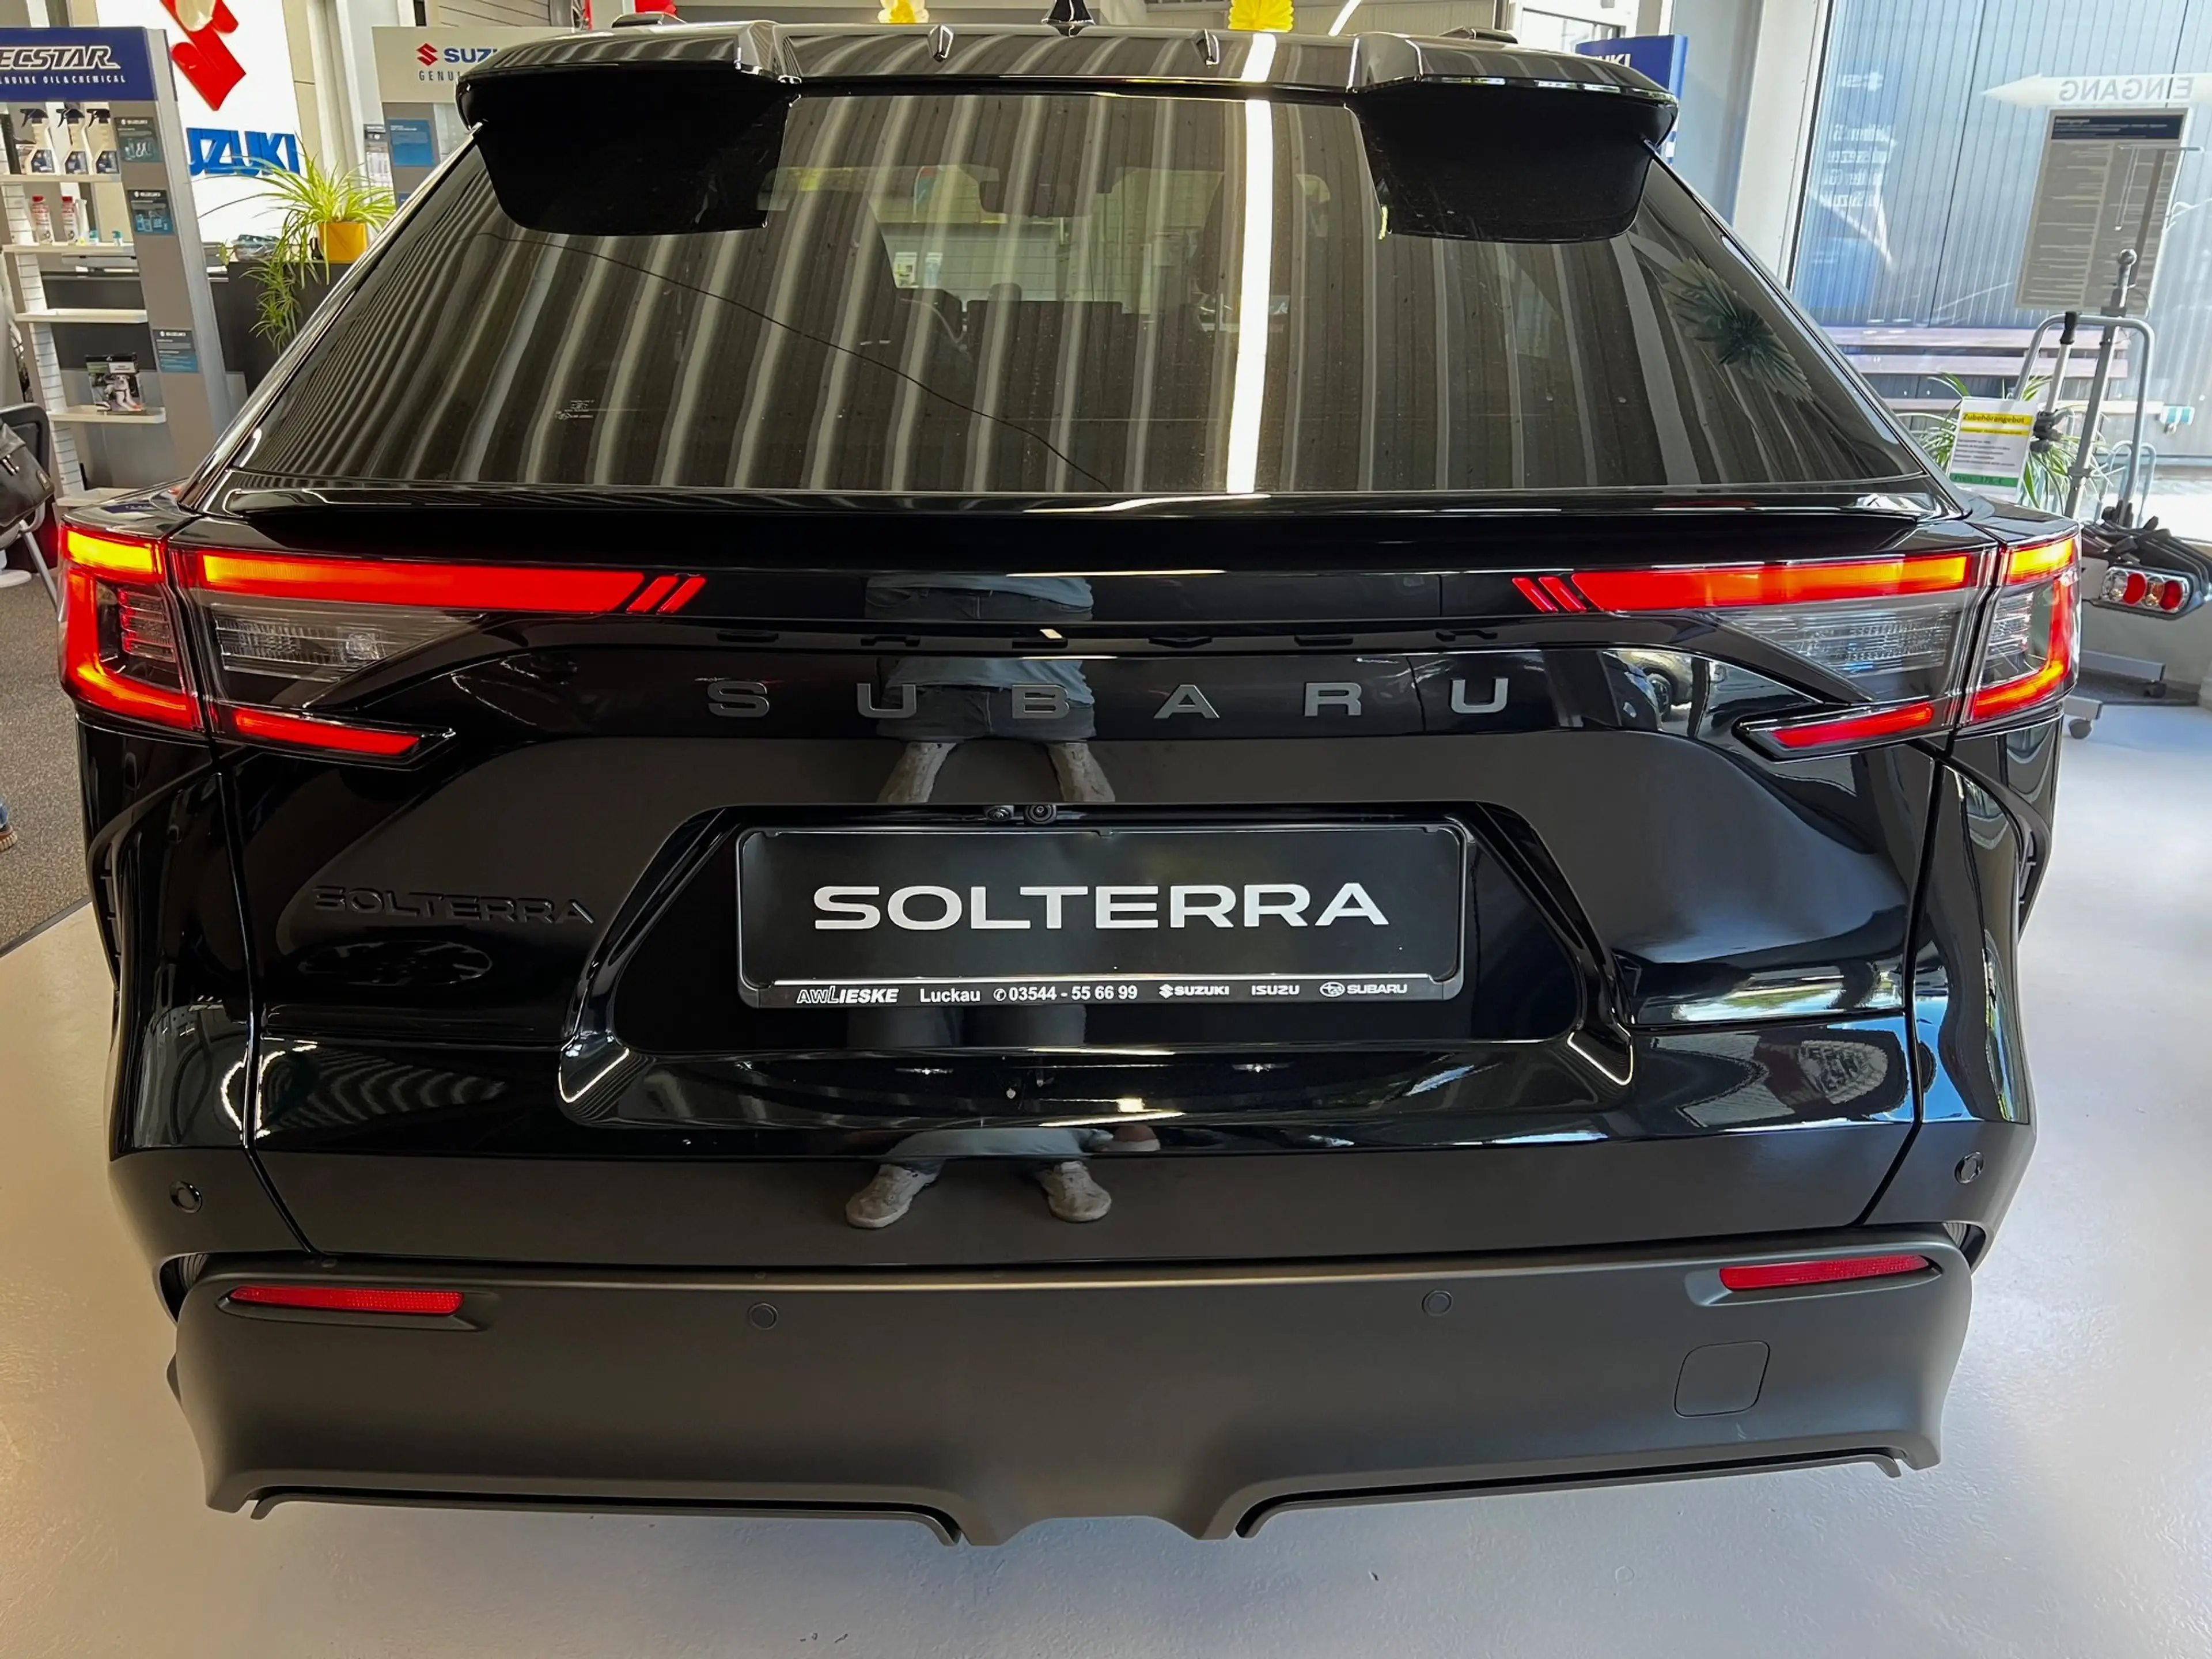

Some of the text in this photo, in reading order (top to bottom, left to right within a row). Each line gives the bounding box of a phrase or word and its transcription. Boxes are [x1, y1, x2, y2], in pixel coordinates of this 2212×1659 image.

[443, 48, 497, 63] SUZ
[0, 75, 36, 84] NUINE
[186, 127, 301, 177] UZUKI
[1963, 413, 2025, 423] Zubehörangebot
[707, 678, 1509, 719] SUBARU
[312, 885, 594, 924] SOLTERRA
[813, 882, 1389, 930] SOLTERRA
[920, 988, 981, 1002] Luckau
[1008, 986, 1056, 1001] 03544
[1071, 986, 1090, 1000] 55
[1094, 986, 1114, 999] 66
[1118, 985, 1138, 999] 99
[1174, 985, 1230, 996] SUZUKI
[1251, 984, 1300, 995] ISUZU
[1347, 983, 1408, 995] SUBARU
